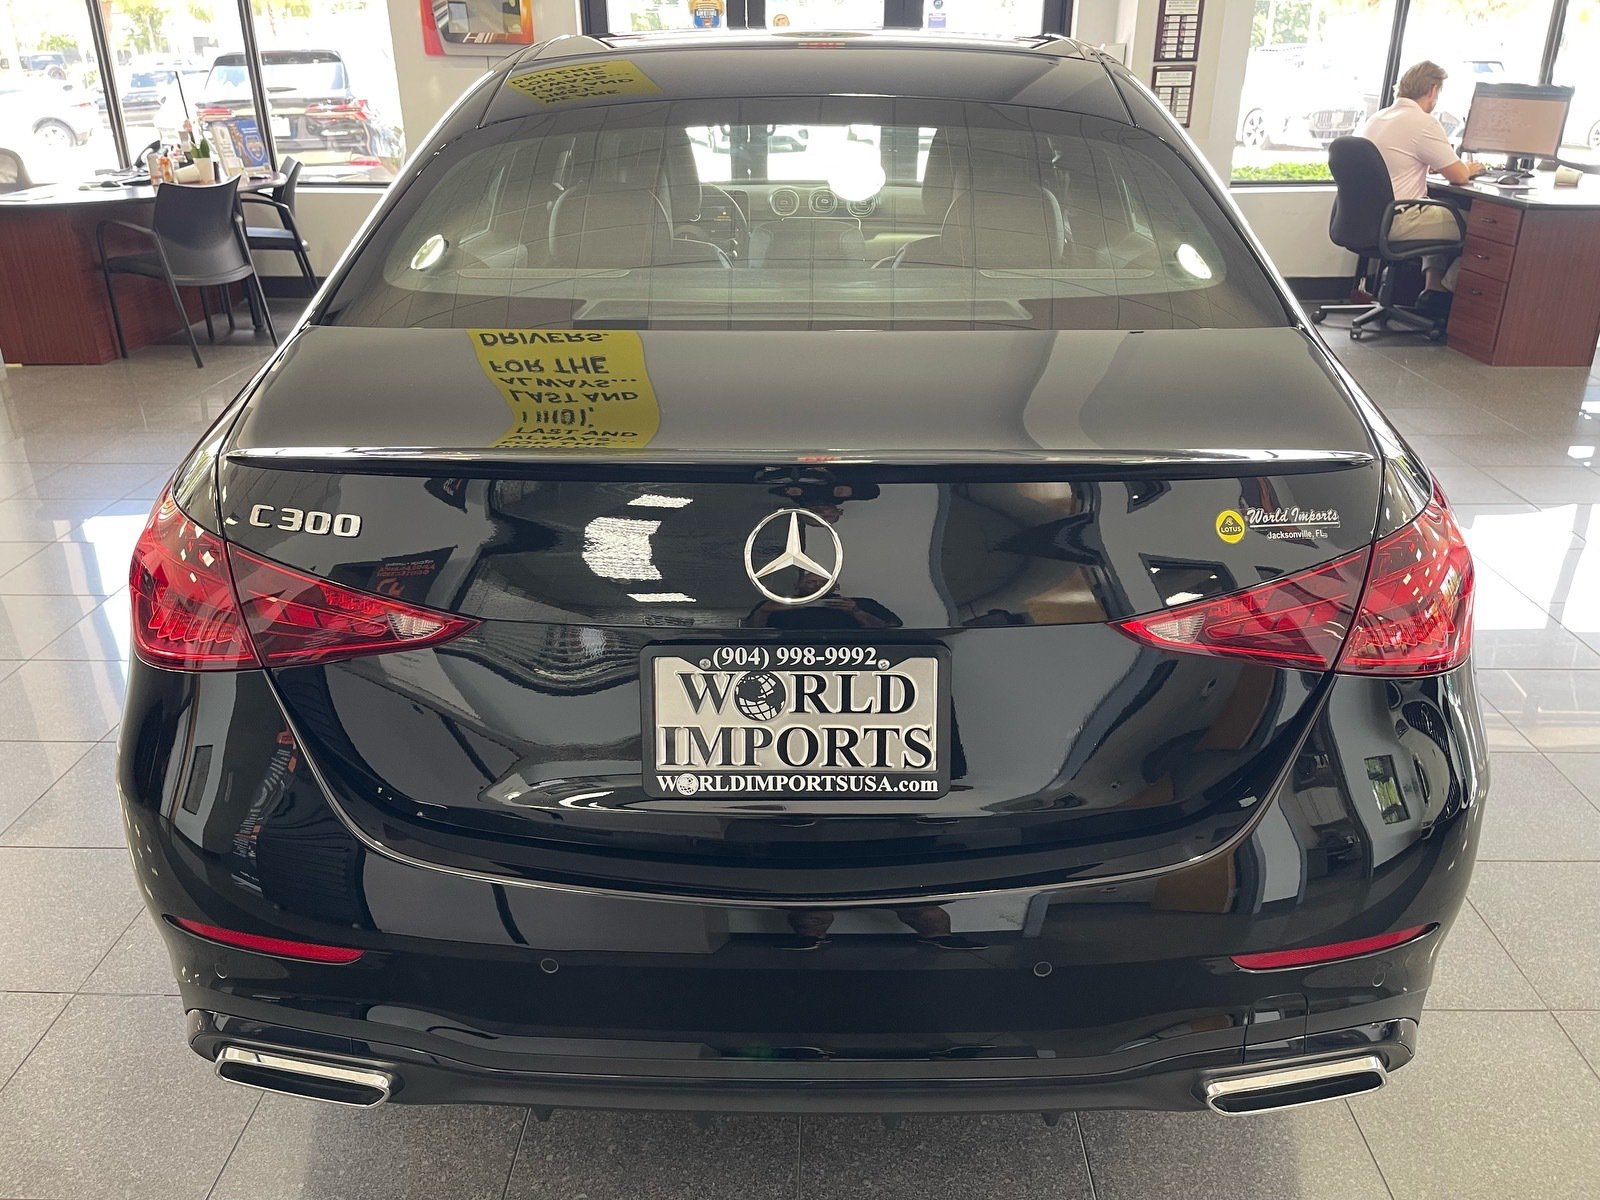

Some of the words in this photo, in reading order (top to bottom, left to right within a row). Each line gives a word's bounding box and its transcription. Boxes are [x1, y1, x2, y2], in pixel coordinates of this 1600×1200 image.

[1246, 508, 1289, 524] World
[1290, 506, 1339, 524] Imports
[1267, 530, 1315, 540] Jacksonville,
[712, 646, 770, 670] (904)
[776, 646, 877, 667] 998-9992
[658, 726, 934, 769] IMPORTS
